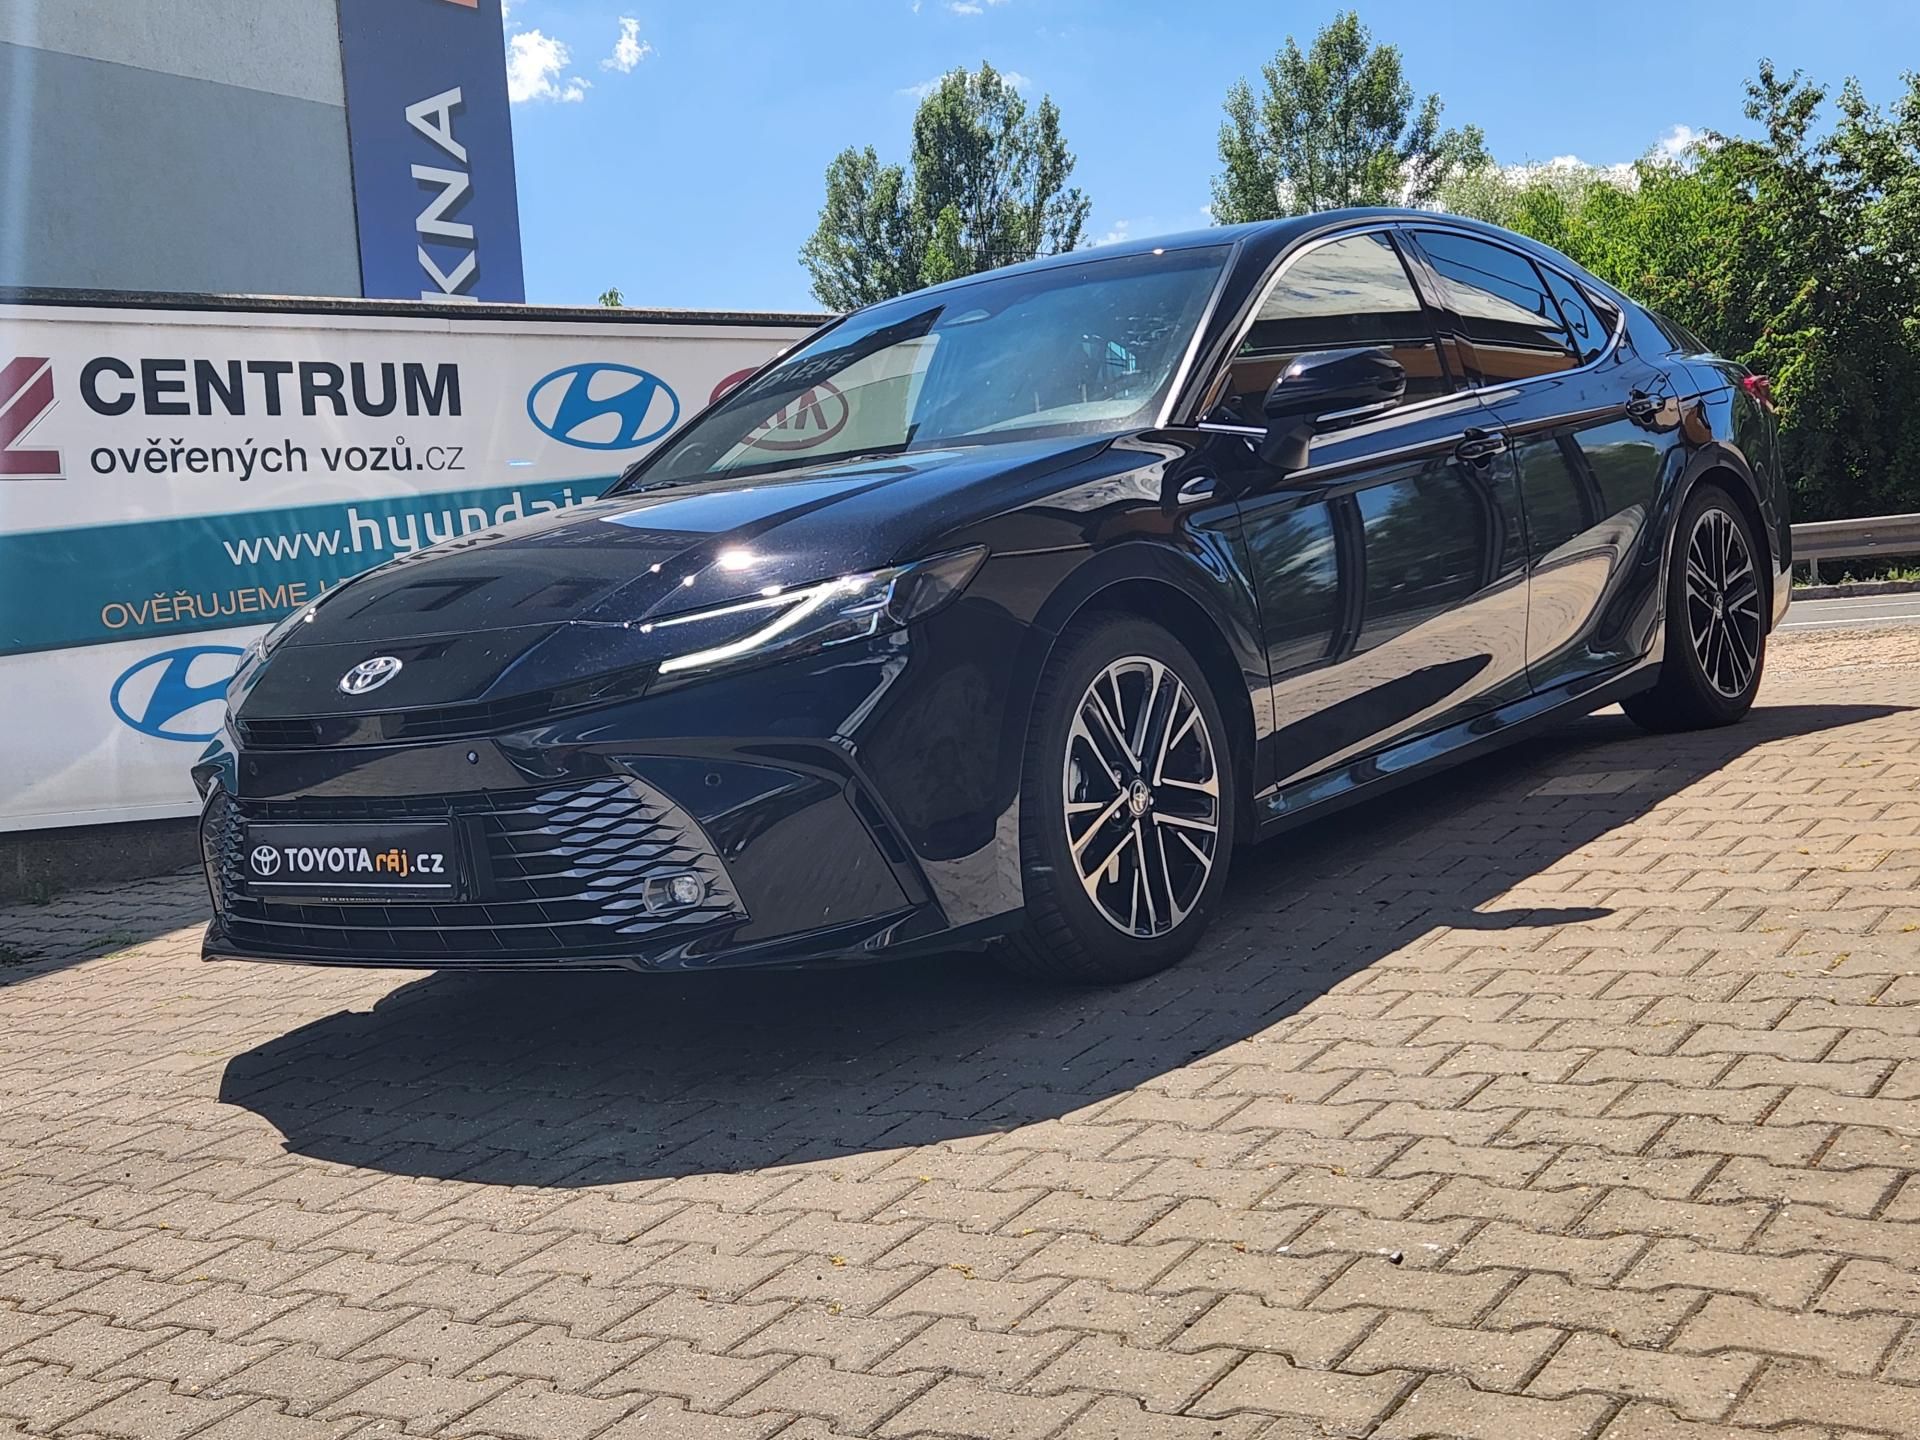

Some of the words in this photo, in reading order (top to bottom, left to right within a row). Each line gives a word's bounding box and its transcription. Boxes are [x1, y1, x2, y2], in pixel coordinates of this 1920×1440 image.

[405, 87, 478, 303] KNA
[79, 356, 462, 417] CENTRUM
[90, 438, 307, 481] ověřených
[101, 582, 308, 628] OVĚŘUJEME
